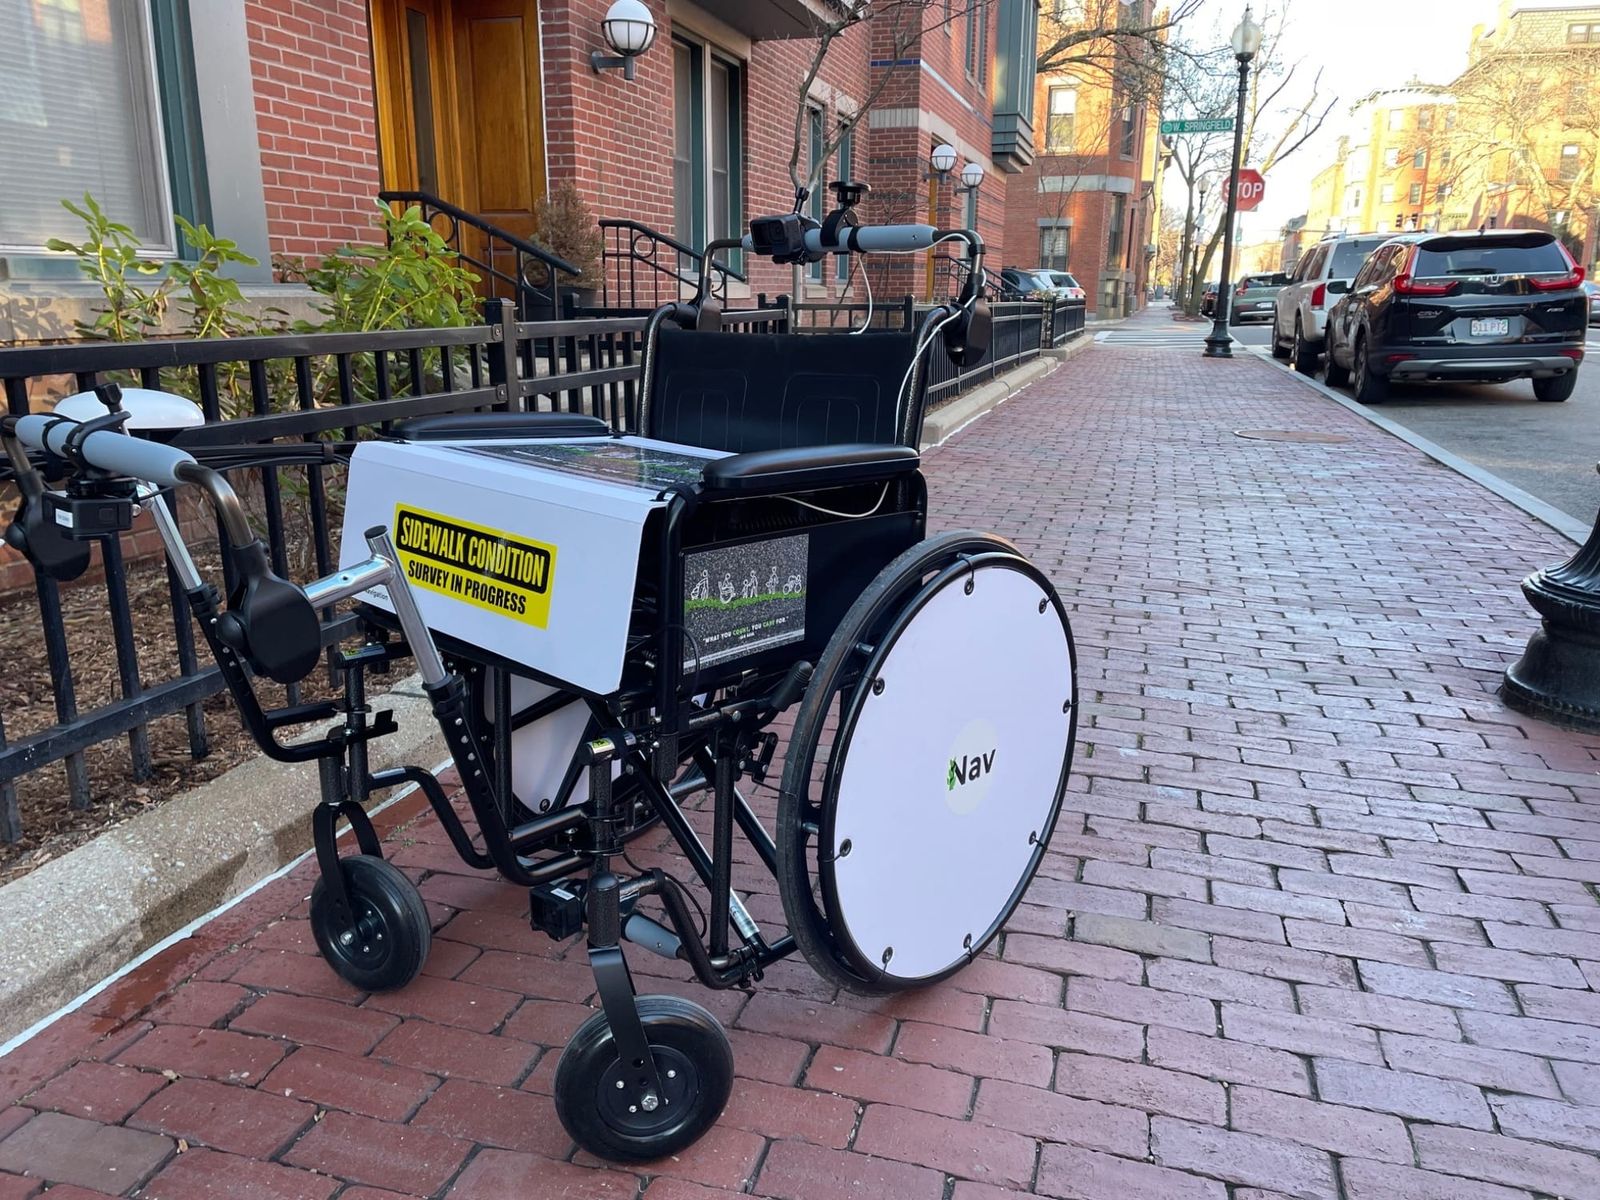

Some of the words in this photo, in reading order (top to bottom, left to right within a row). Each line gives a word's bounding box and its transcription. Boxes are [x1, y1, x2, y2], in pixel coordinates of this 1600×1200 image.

[1184, 119, 1231, 131] SPRINGFIELD
[400, 516, 466, 563] SIDEWALK
[468, 535, 546, 588] CONDITION
[408, 560, 450, 589] SURVEY
[450, 575, 464, 593] IN
[464, 578, 527, 615] PROGRESS
